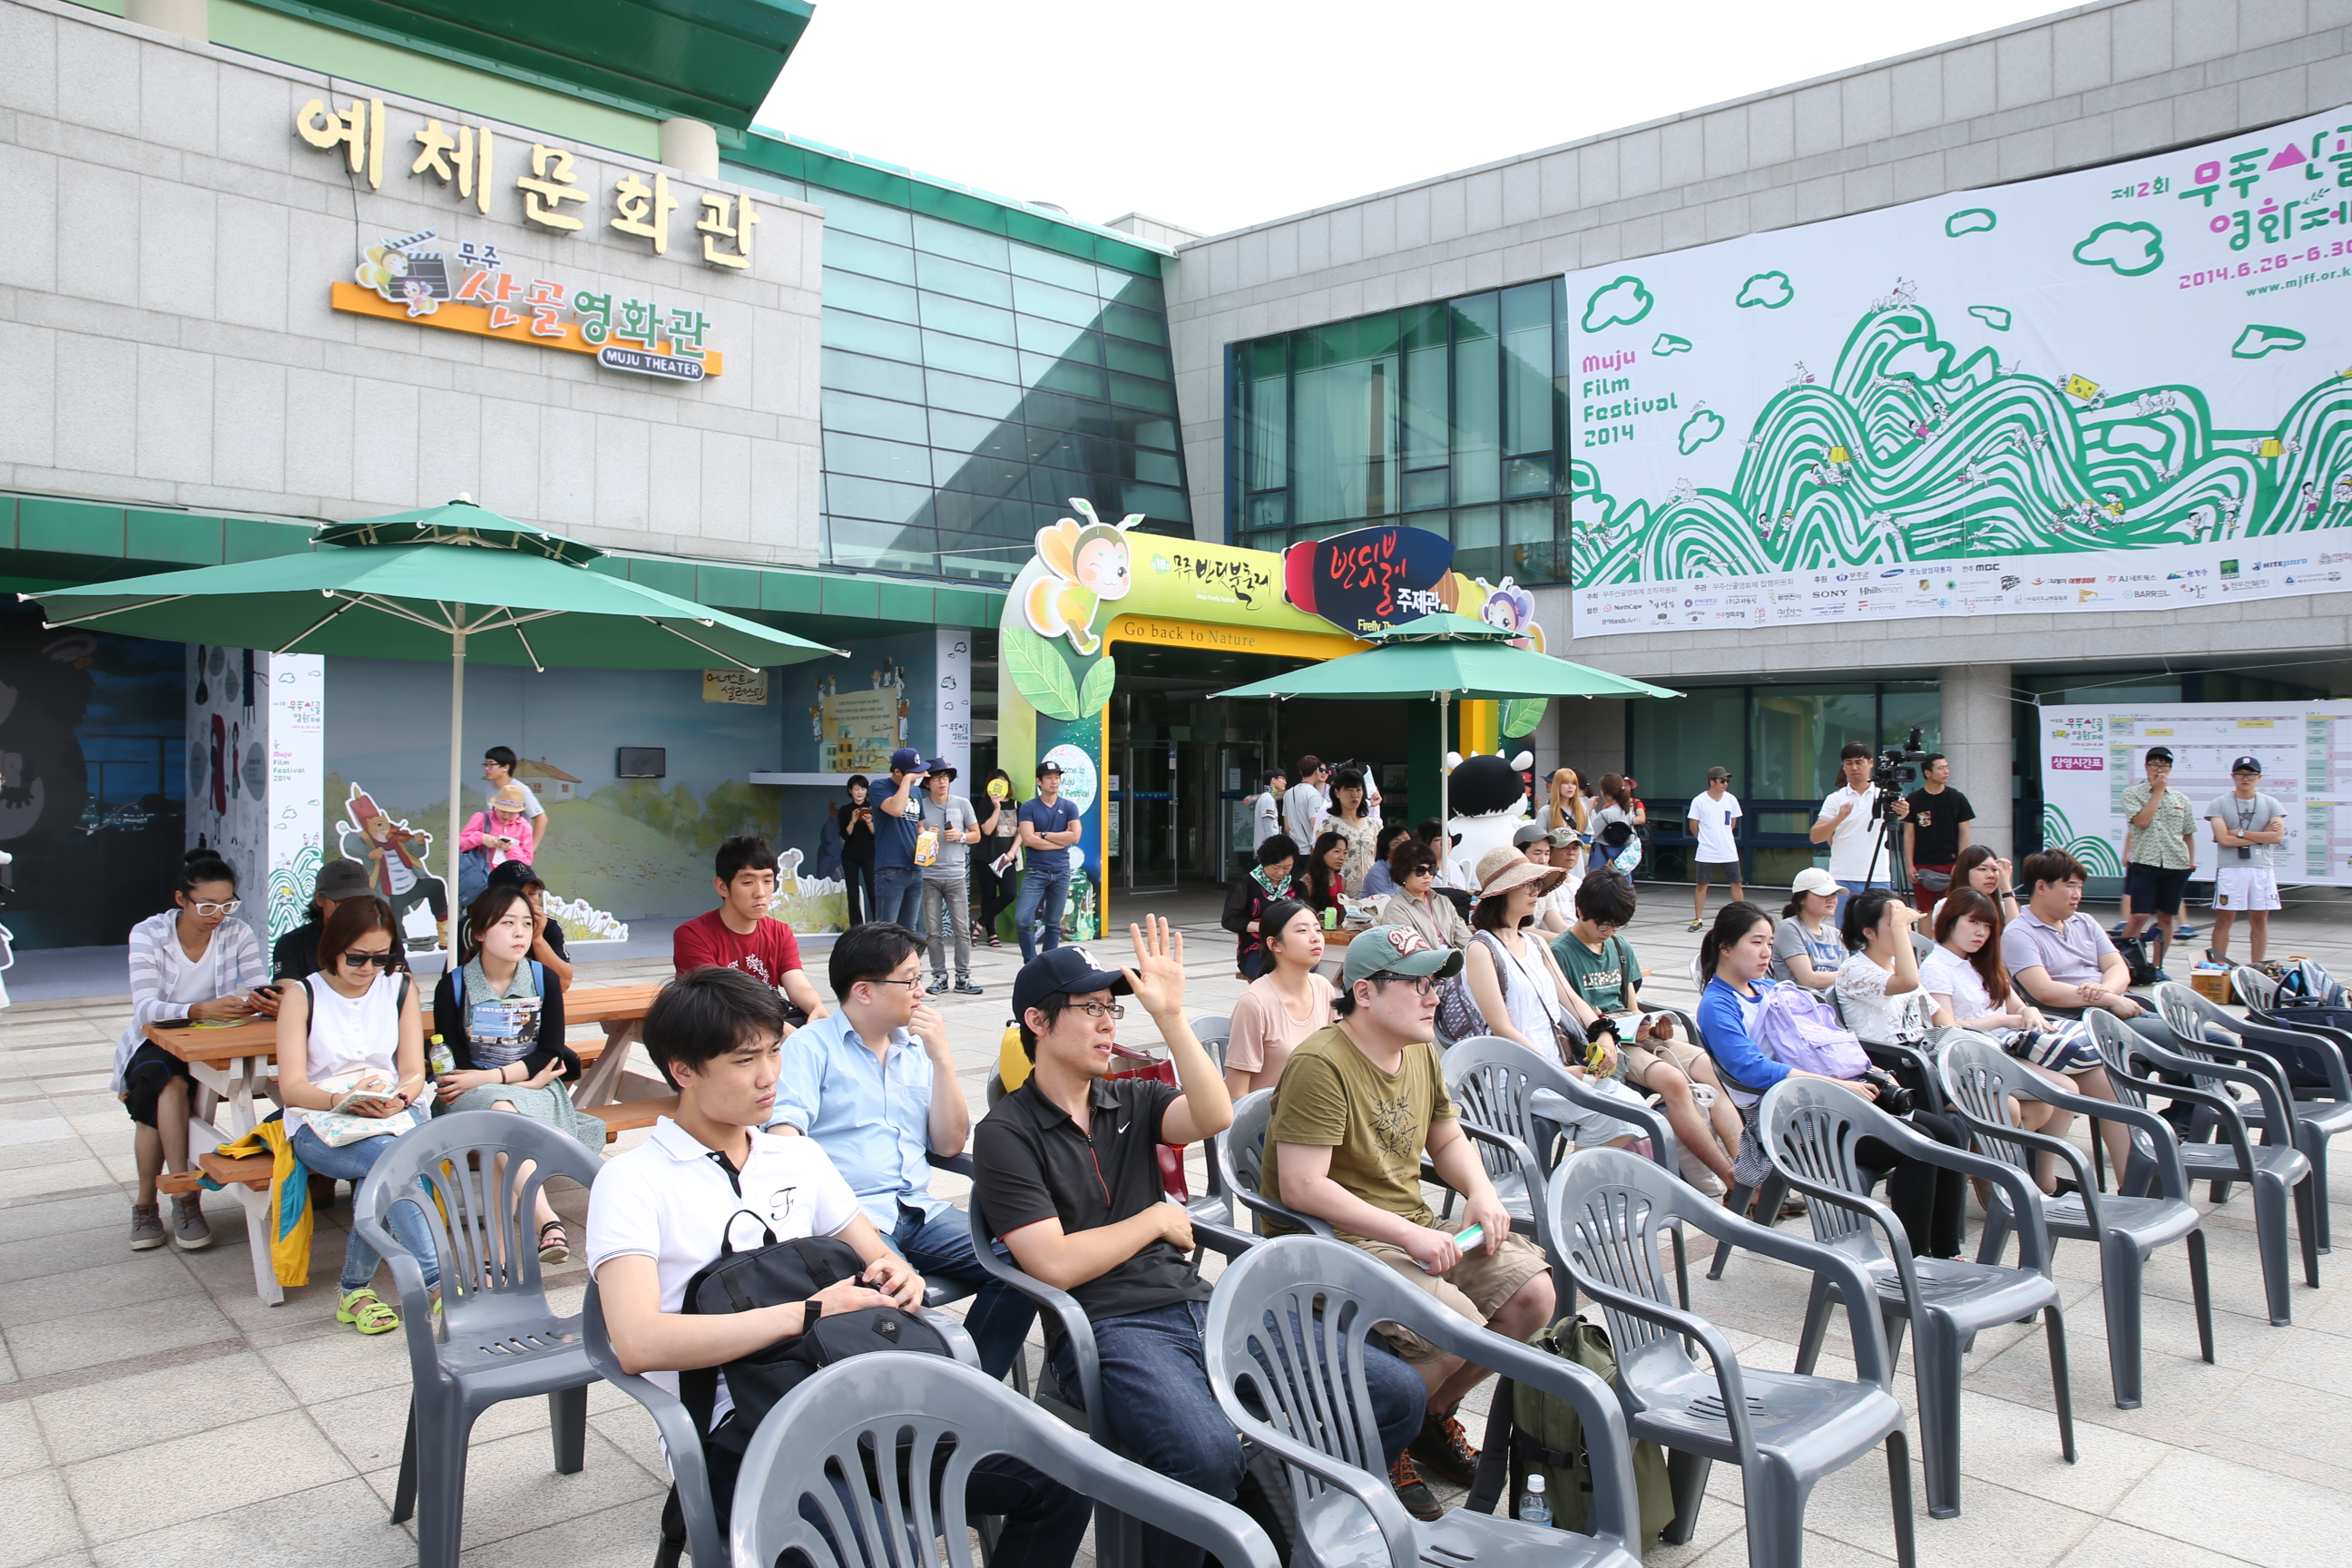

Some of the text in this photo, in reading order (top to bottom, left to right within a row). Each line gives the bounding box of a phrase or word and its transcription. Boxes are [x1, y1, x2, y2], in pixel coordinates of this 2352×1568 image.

[296, 97, 761, 270] 예체문화관
[2111, 176, 2171, 200] 제2회
[2209, 197, 2352, 251] 영화제
[456, 242, 503, 270] 무주
[606, 349, 700, 377] MUJU THEATER
[1582, 349, 1636, 374] Muju
[1583, 377, 1630, 399] Film
[1583, 392, 1679, 424] Festival
[1583, 424, 1634, 448] 2014
[1909, 565, 1953, 575] 르노삼성자동차
[1396, 587, 1441, 615] 주제관
[1812, 589, 1849, 599] SONY
[2134, 590, 2171, 599] BARREL
[1613, 603, 1642, 611] NorthCape
[1123, 621, 1256, 647] Go back to Nature
[1357, 618, 1381, 632] Firefly
[2053, 757, 2102, 769] 상영시간표
[1065, 789, 1090, 798] Festival
